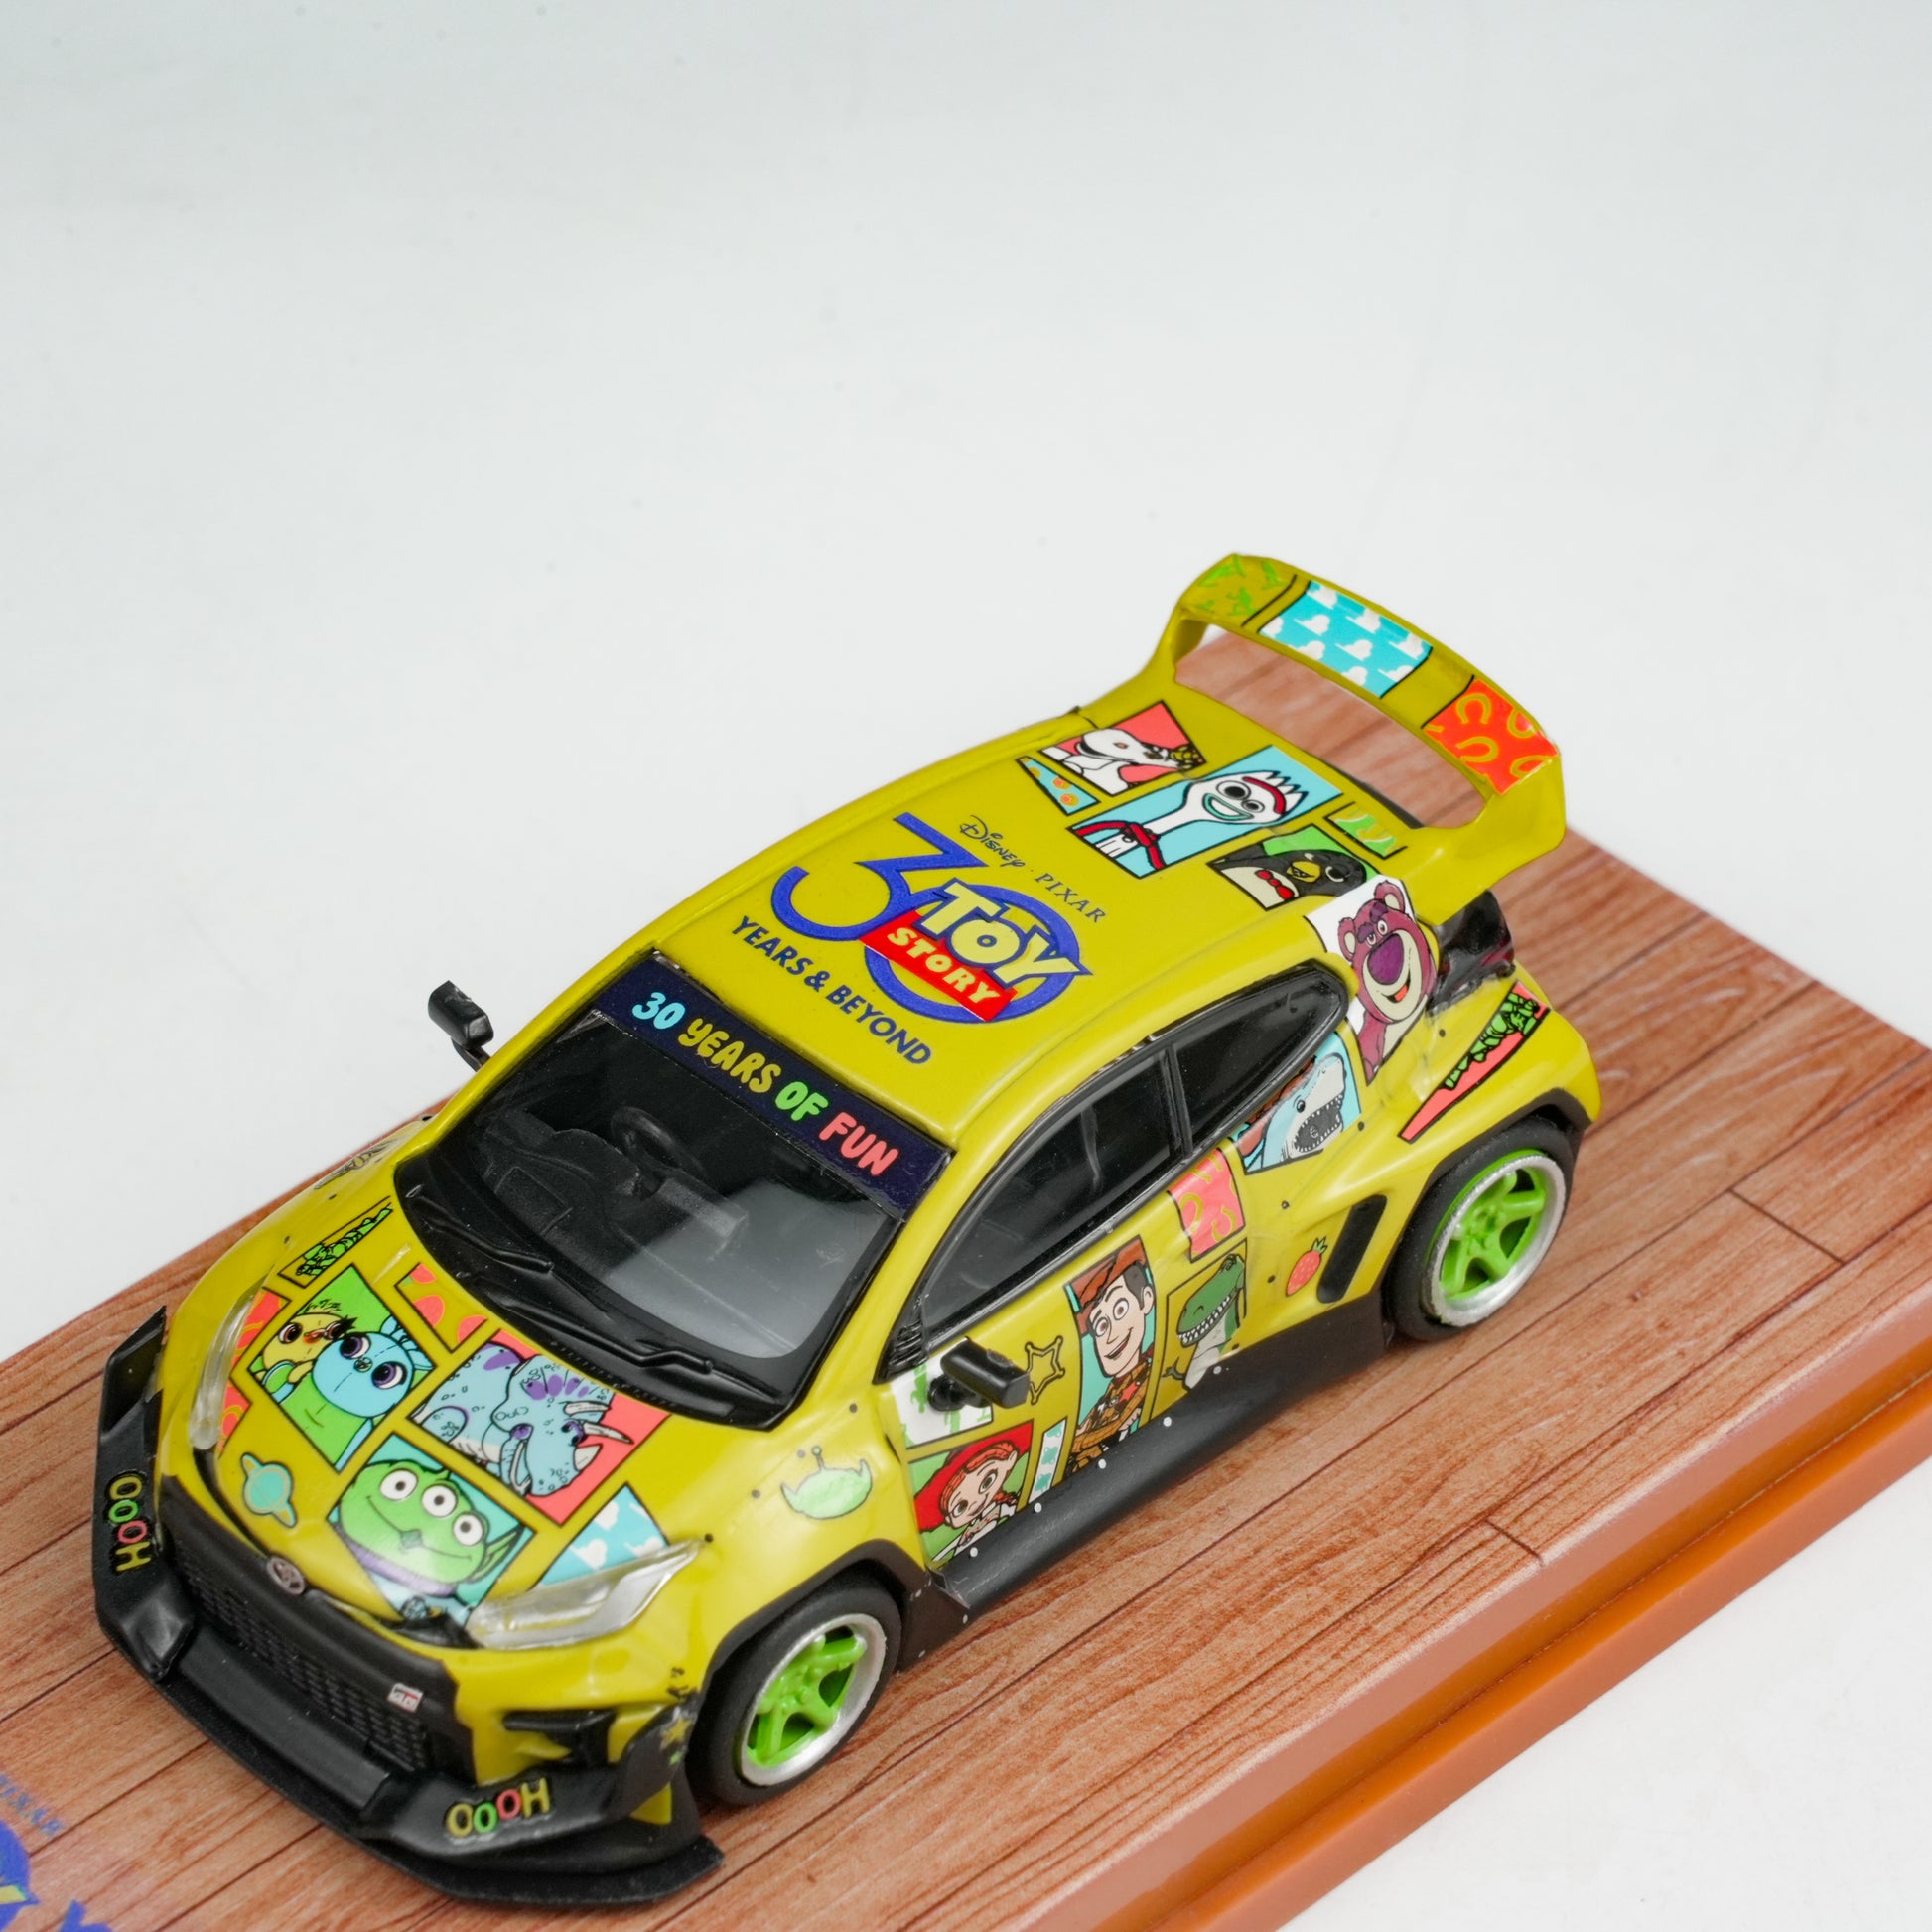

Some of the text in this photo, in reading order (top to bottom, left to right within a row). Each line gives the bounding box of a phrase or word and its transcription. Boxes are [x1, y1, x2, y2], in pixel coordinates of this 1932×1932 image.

[911, 877, 1093, 989] TOY
[1035, 873, 1107, 924] PIXAR
[732, 915, 932, 1065] YEARS & BEYOND
[887, 927, 1002, 1004] STORY
[632, 991, 900, 1176] 30 YEARS OF FUN
